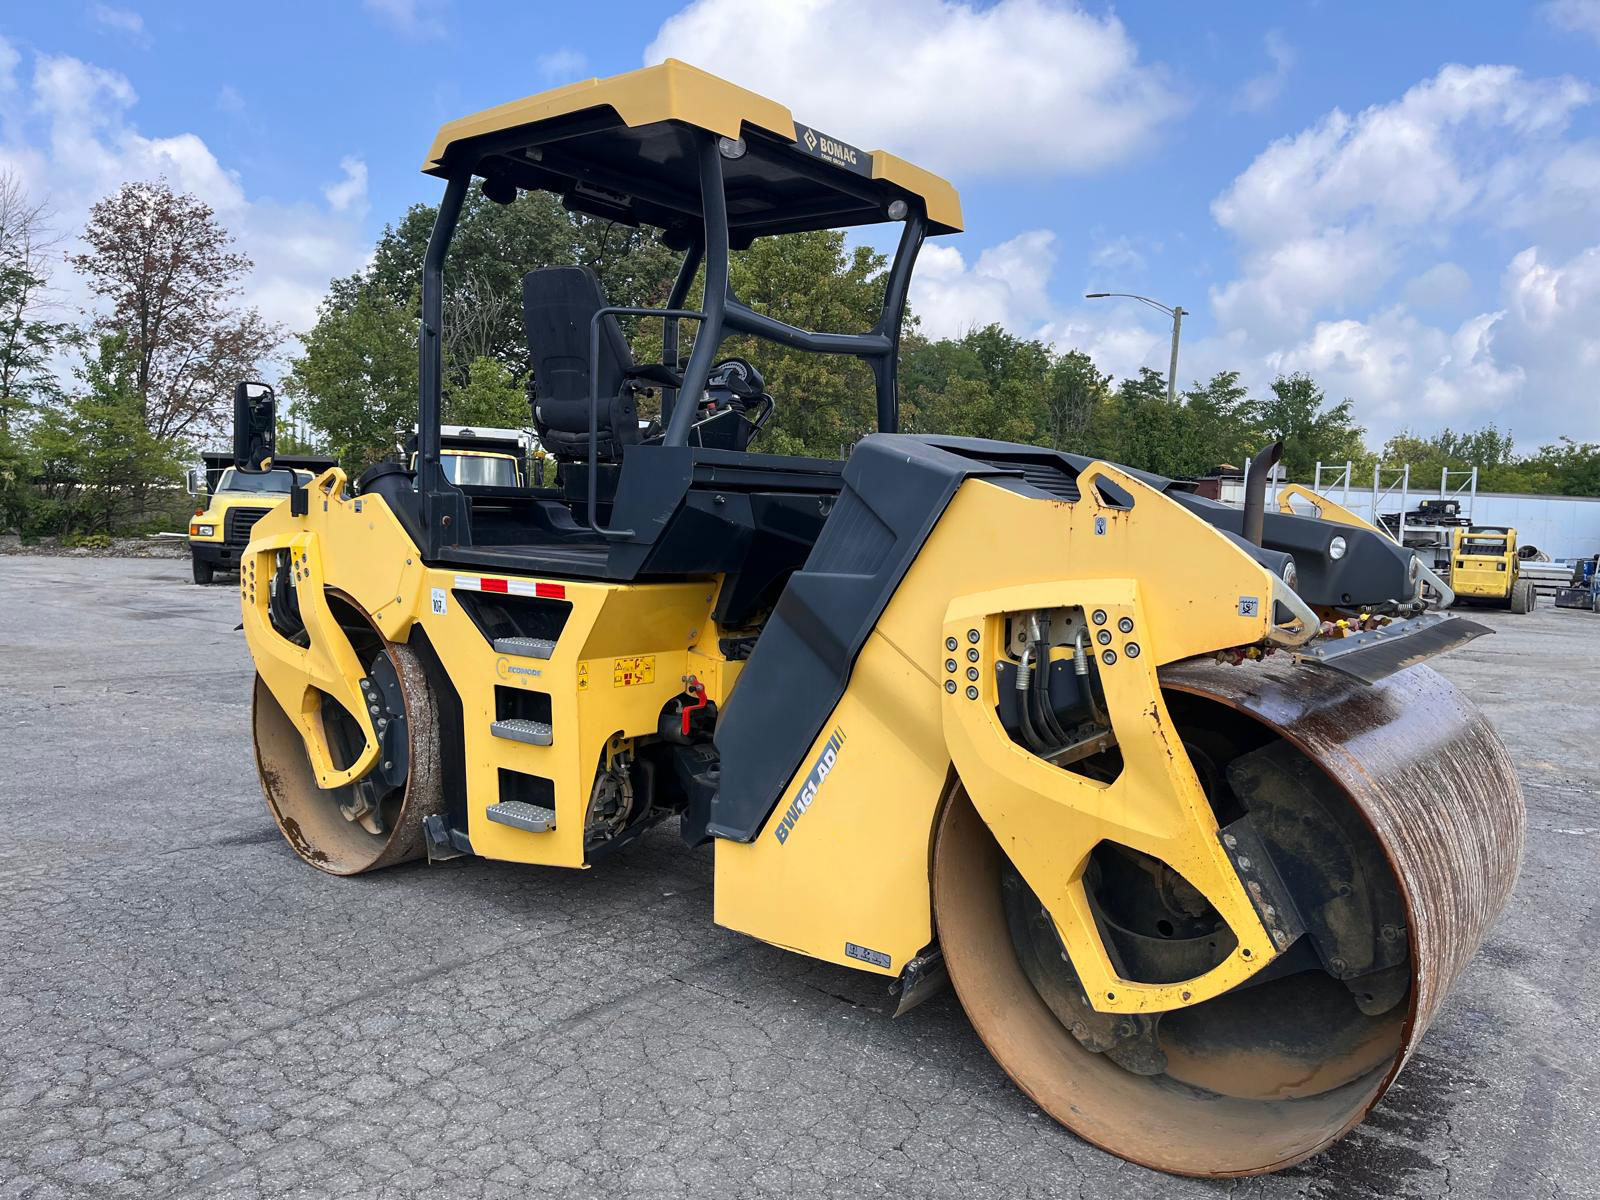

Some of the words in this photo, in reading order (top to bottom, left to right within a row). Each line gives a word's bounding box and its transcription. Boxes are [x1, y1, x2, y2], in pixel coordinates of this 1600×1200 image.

[819, 136, 857, 165] BOMAG
[507, 666, 542, 677] ECOMODE
[816, 748, 837, 784] AD
